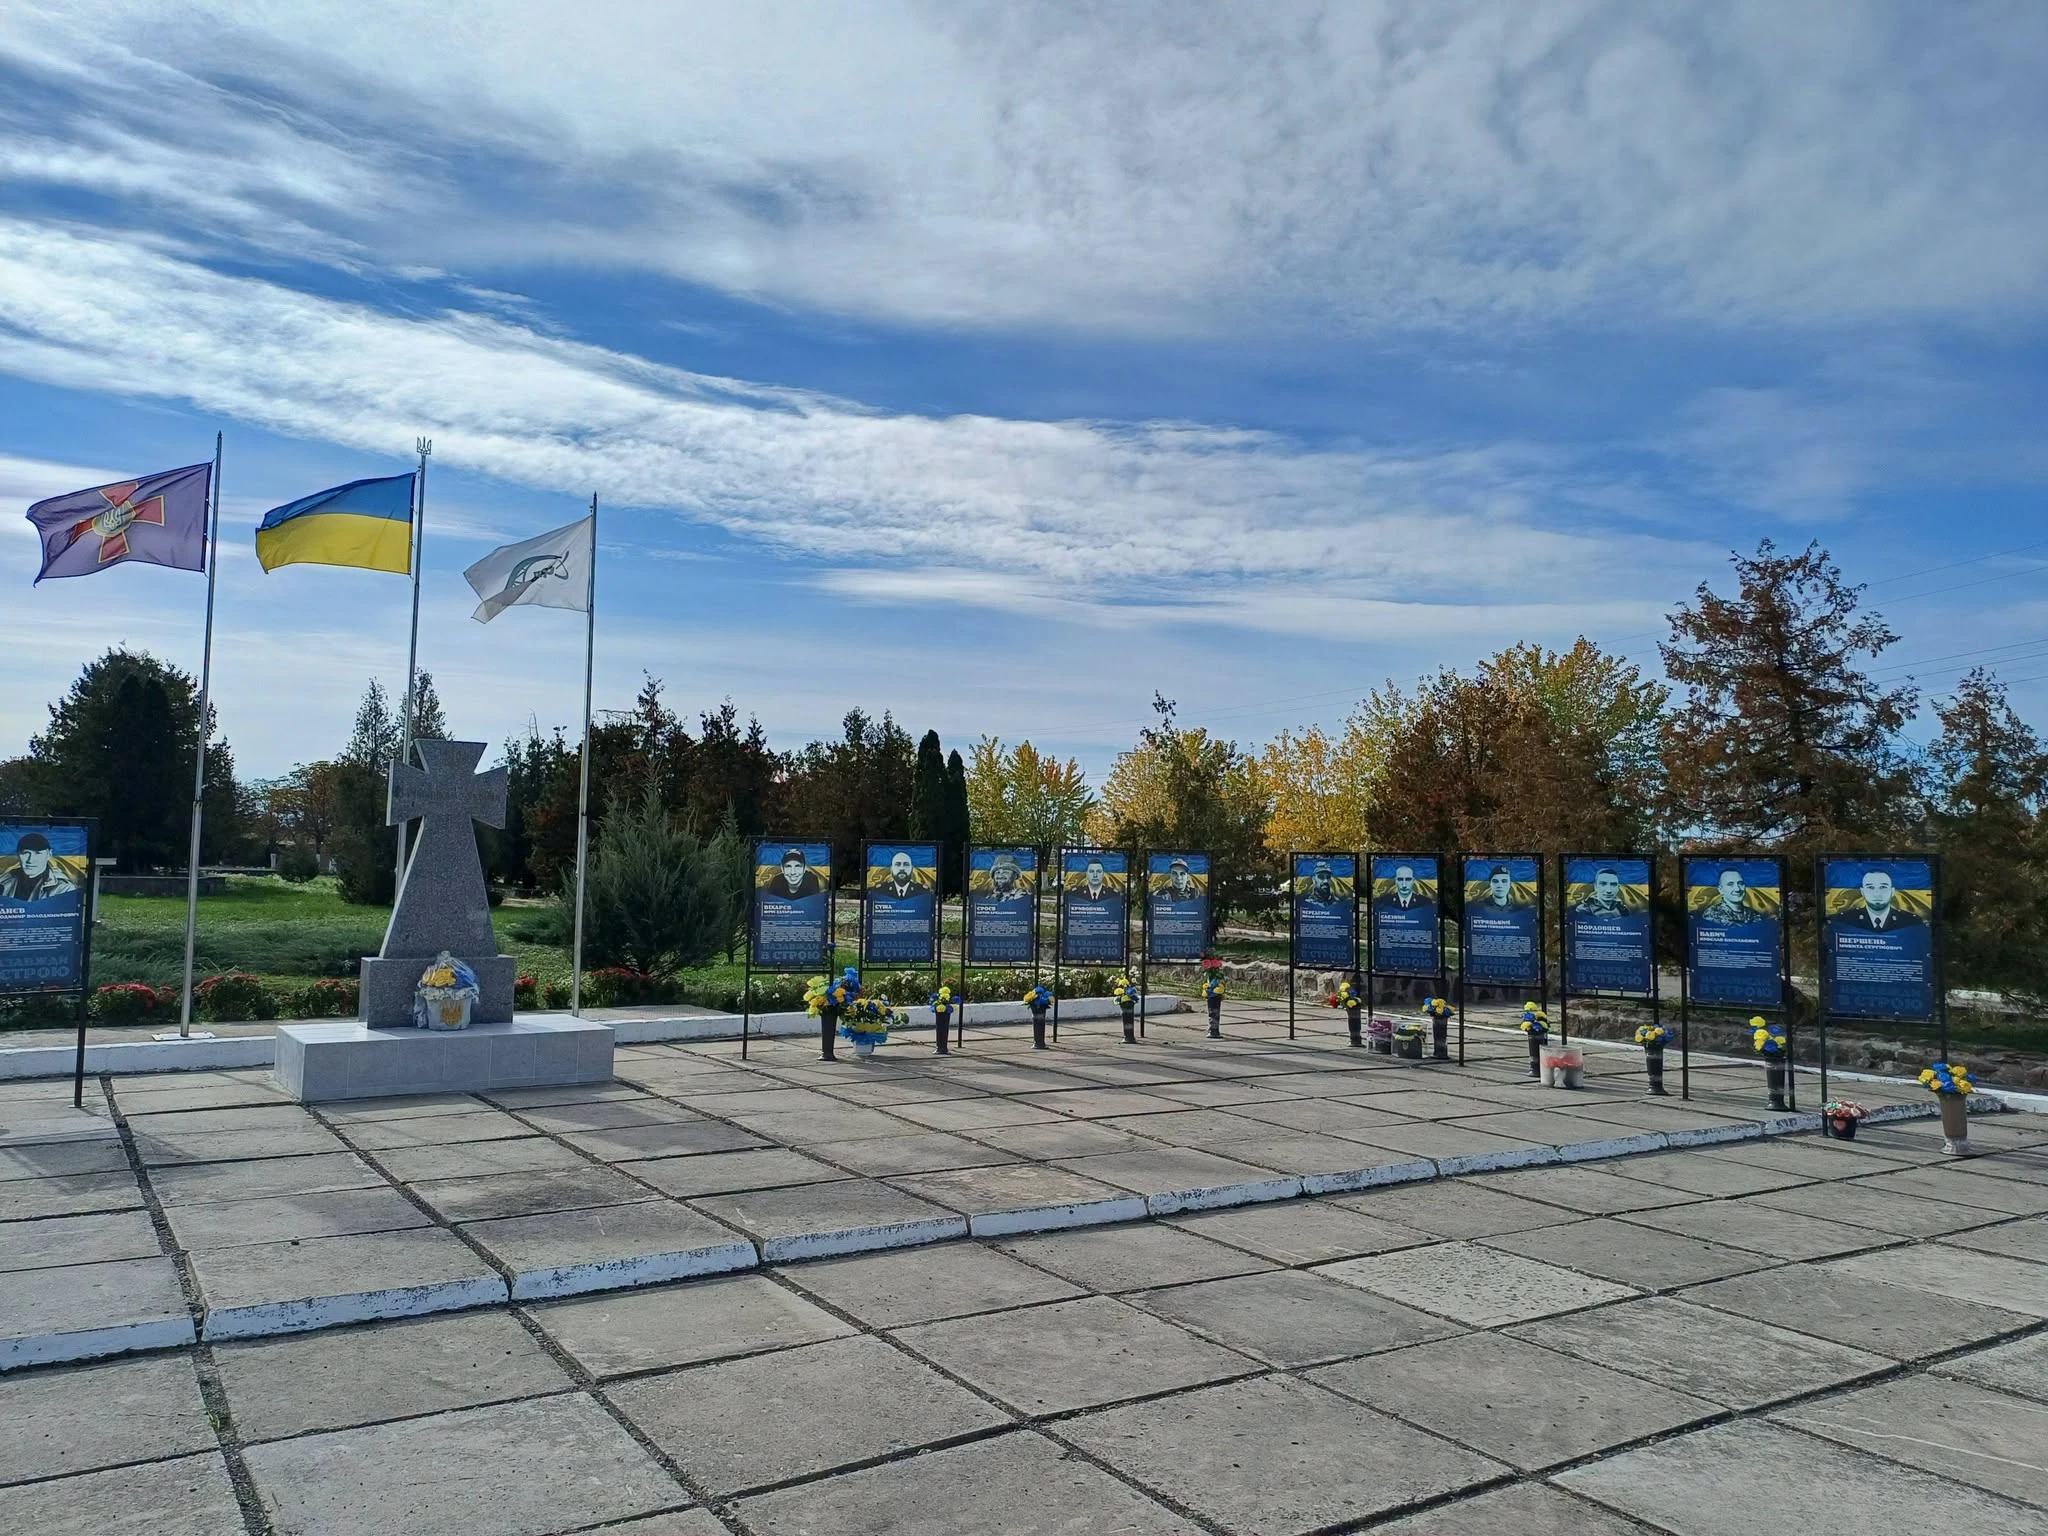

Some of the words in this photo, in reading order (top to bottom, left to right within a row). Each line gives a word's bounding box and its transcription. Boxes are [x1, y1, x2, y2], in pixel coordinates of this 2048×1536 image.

[761, 951, 769, 960] В
[772, 950, 820, 960] СТРОЮ
[872, 948, 880, 956] В
[883, 948, 928, 957] СТРОЮ
[985, 948, 1027, 956] СТРОЮ
[1310, 951, 1347, 960] СТРОЮ
[0, 956, 68, 967] ЗАВЖДИ
[1390, 958, 1432, 967] СТРОЮ
[1472, 965, 1481, 973] В
[1484, 965, 1530, 975] СТРОЮ
[1577, 973, 1586, 982] В
[1590, 974, 1642, 984] СТРОЮ
[1713, 985, 1772, 998] СТРОЮ
[1855, 996, 1923, 1010] СТРОЮ
